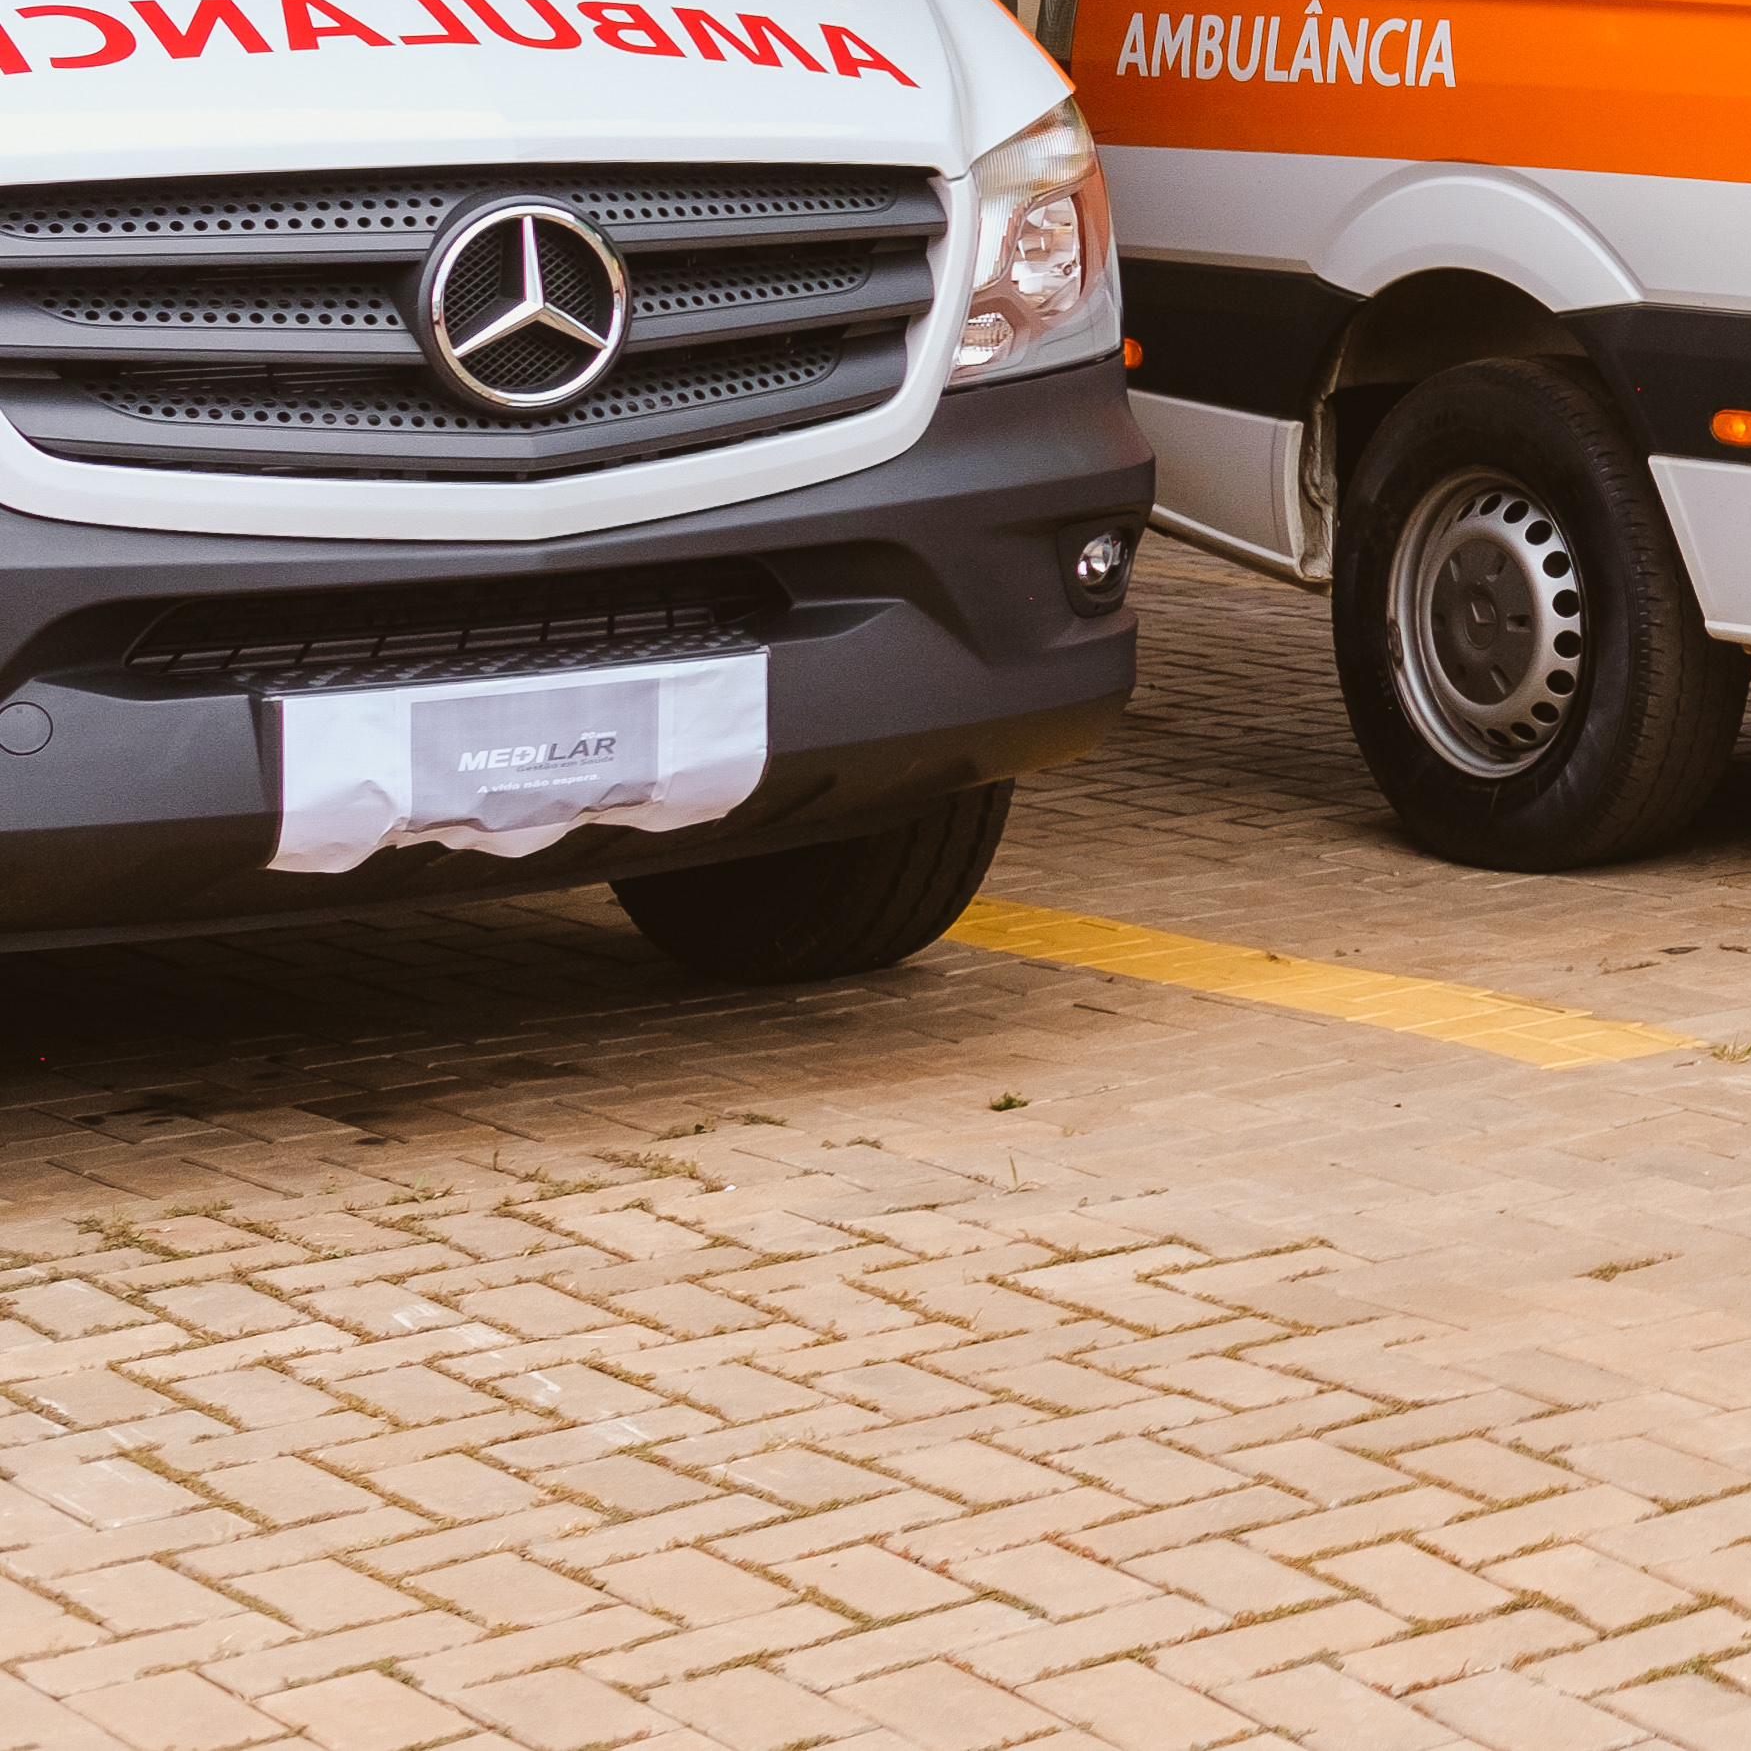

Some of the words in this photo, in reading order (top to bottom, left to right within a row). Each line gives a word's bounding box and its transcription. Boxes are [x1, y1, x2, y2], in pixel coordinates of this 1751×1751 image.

[457, 736, 617, 772] MEDILAR
[476, 785, 488, 794] A
[491, 781, 521, 792] vida
[522, 778, 551, 788] não
